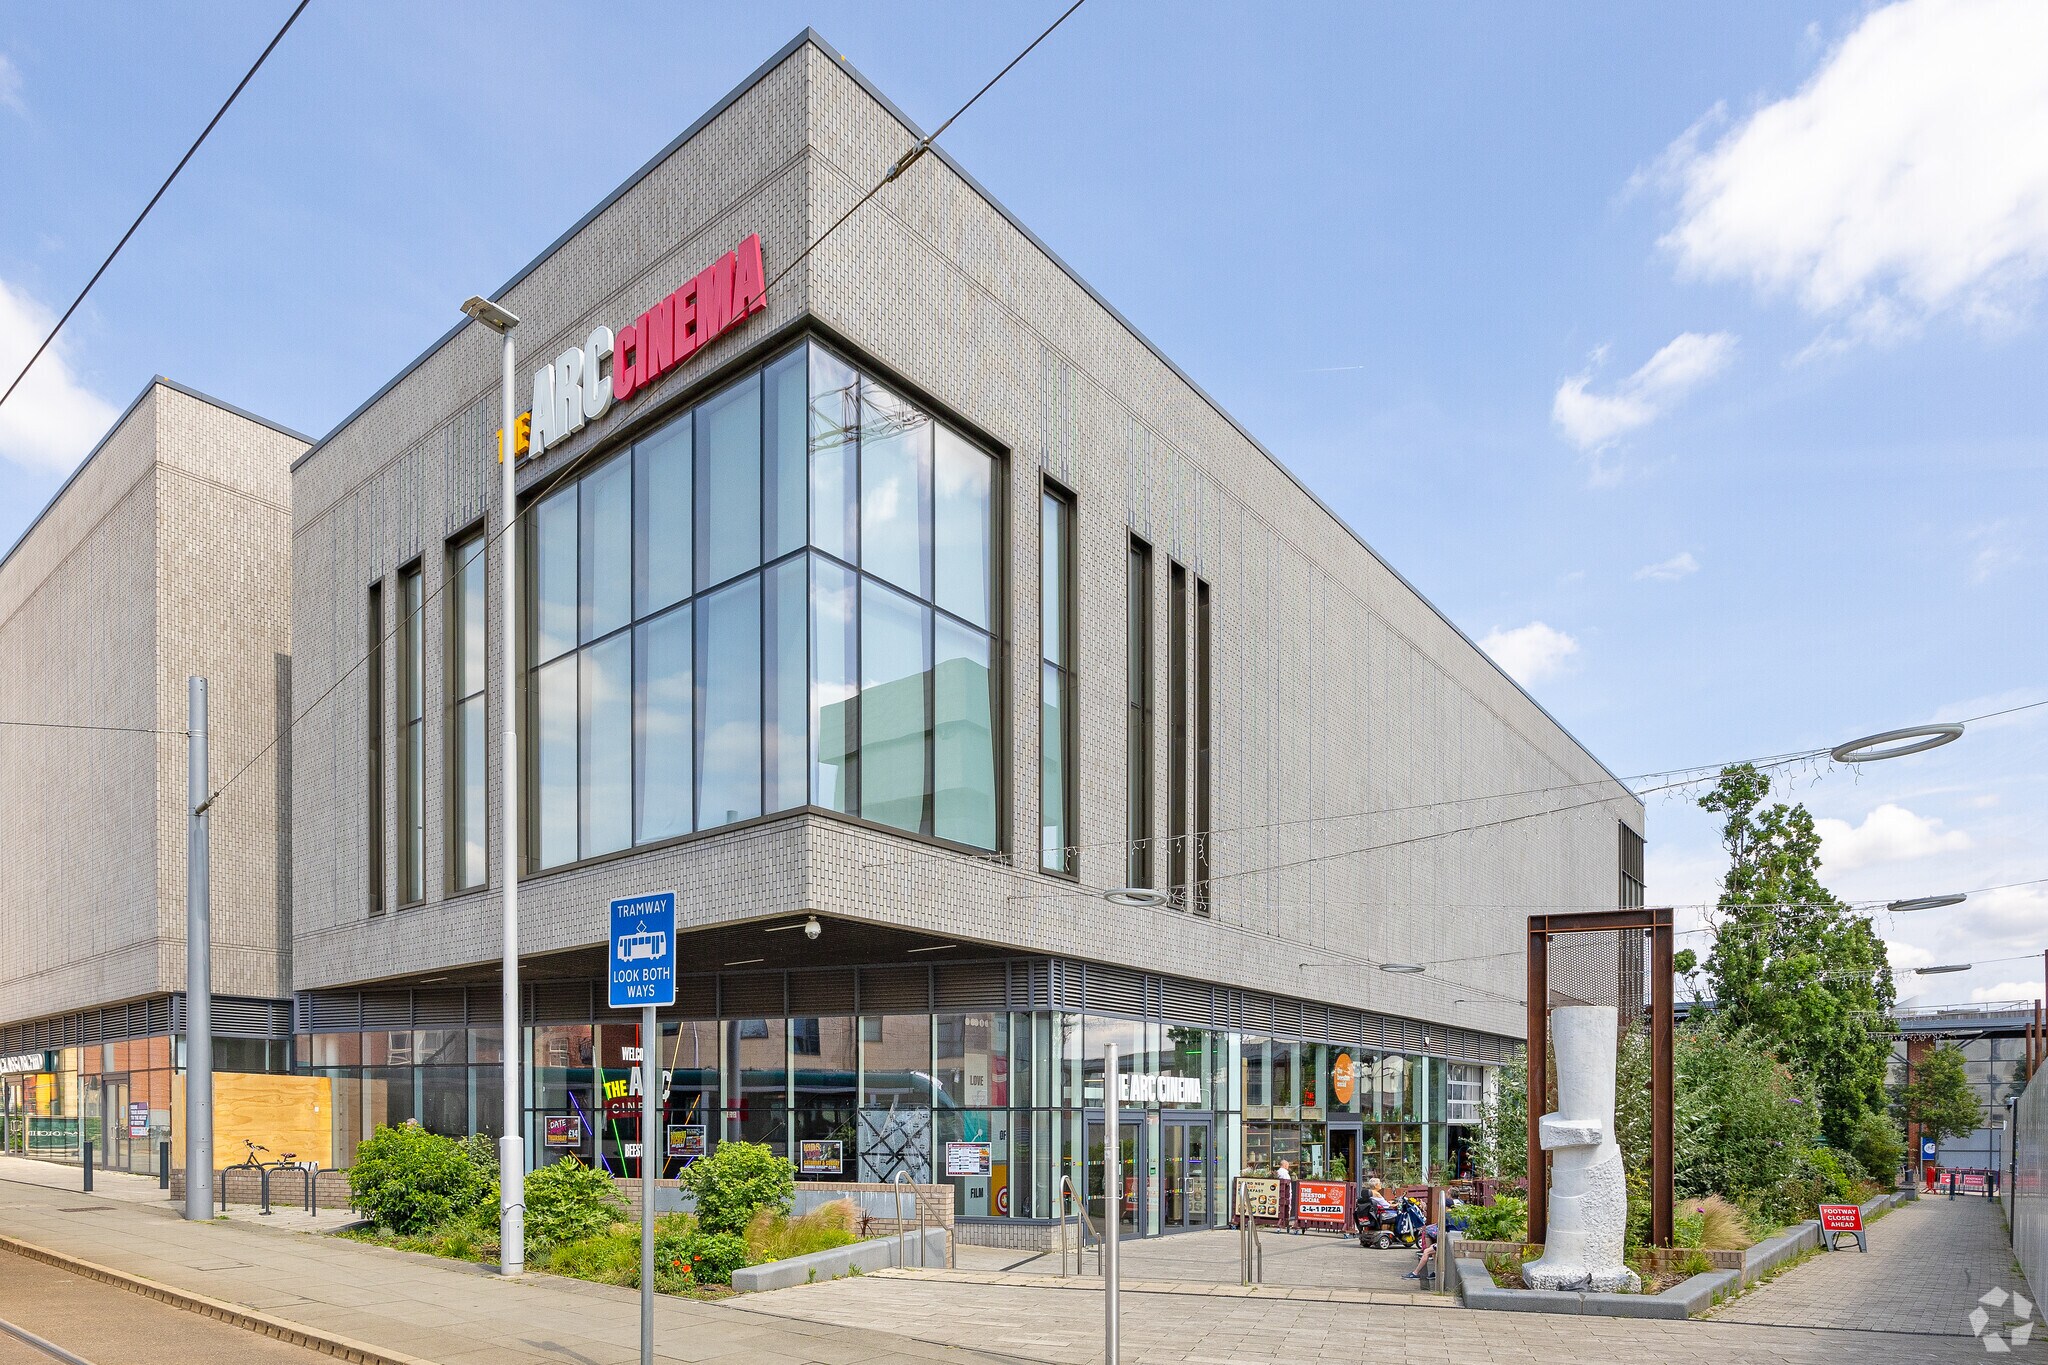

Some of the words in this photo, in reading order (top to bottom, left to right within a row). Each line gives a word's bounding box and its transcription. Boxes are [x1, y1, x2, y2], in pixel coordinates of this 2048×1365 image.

[496, 411, 531, 464] TE
[529, 326, 614, 460] ARC
[613, 233, 767, 402] CINEMA
[617, 899, 667, 918] TRAMWAY
[613, 969, 640, 983] LOOK
[642, 966, 670, 981] BOTH
[627, 984, 655, 998] WAYS
[621, 1046, 643, 1061] WELCO
[604, 1080, 628, 1099] THE
[628, 1066, 671, 1100] AC
[969, 1075, 984, 1086] LOVE
[1130, 1075, 1157, 1102] ARC
[1157, 1075, 1201, 1103] CINEMA
[612, 1102, 643, 1114] CINE
[550, 1119, 567, 1129] DATE
[568, 1129, 578, 1138] £14
[1000, 1130, 1007, 1141] OF
[624, 1144, 643, 1158] BEEST
[803, 1143, 821, 1152] KIDS
[970, 1187, 984, 1199] FILM
